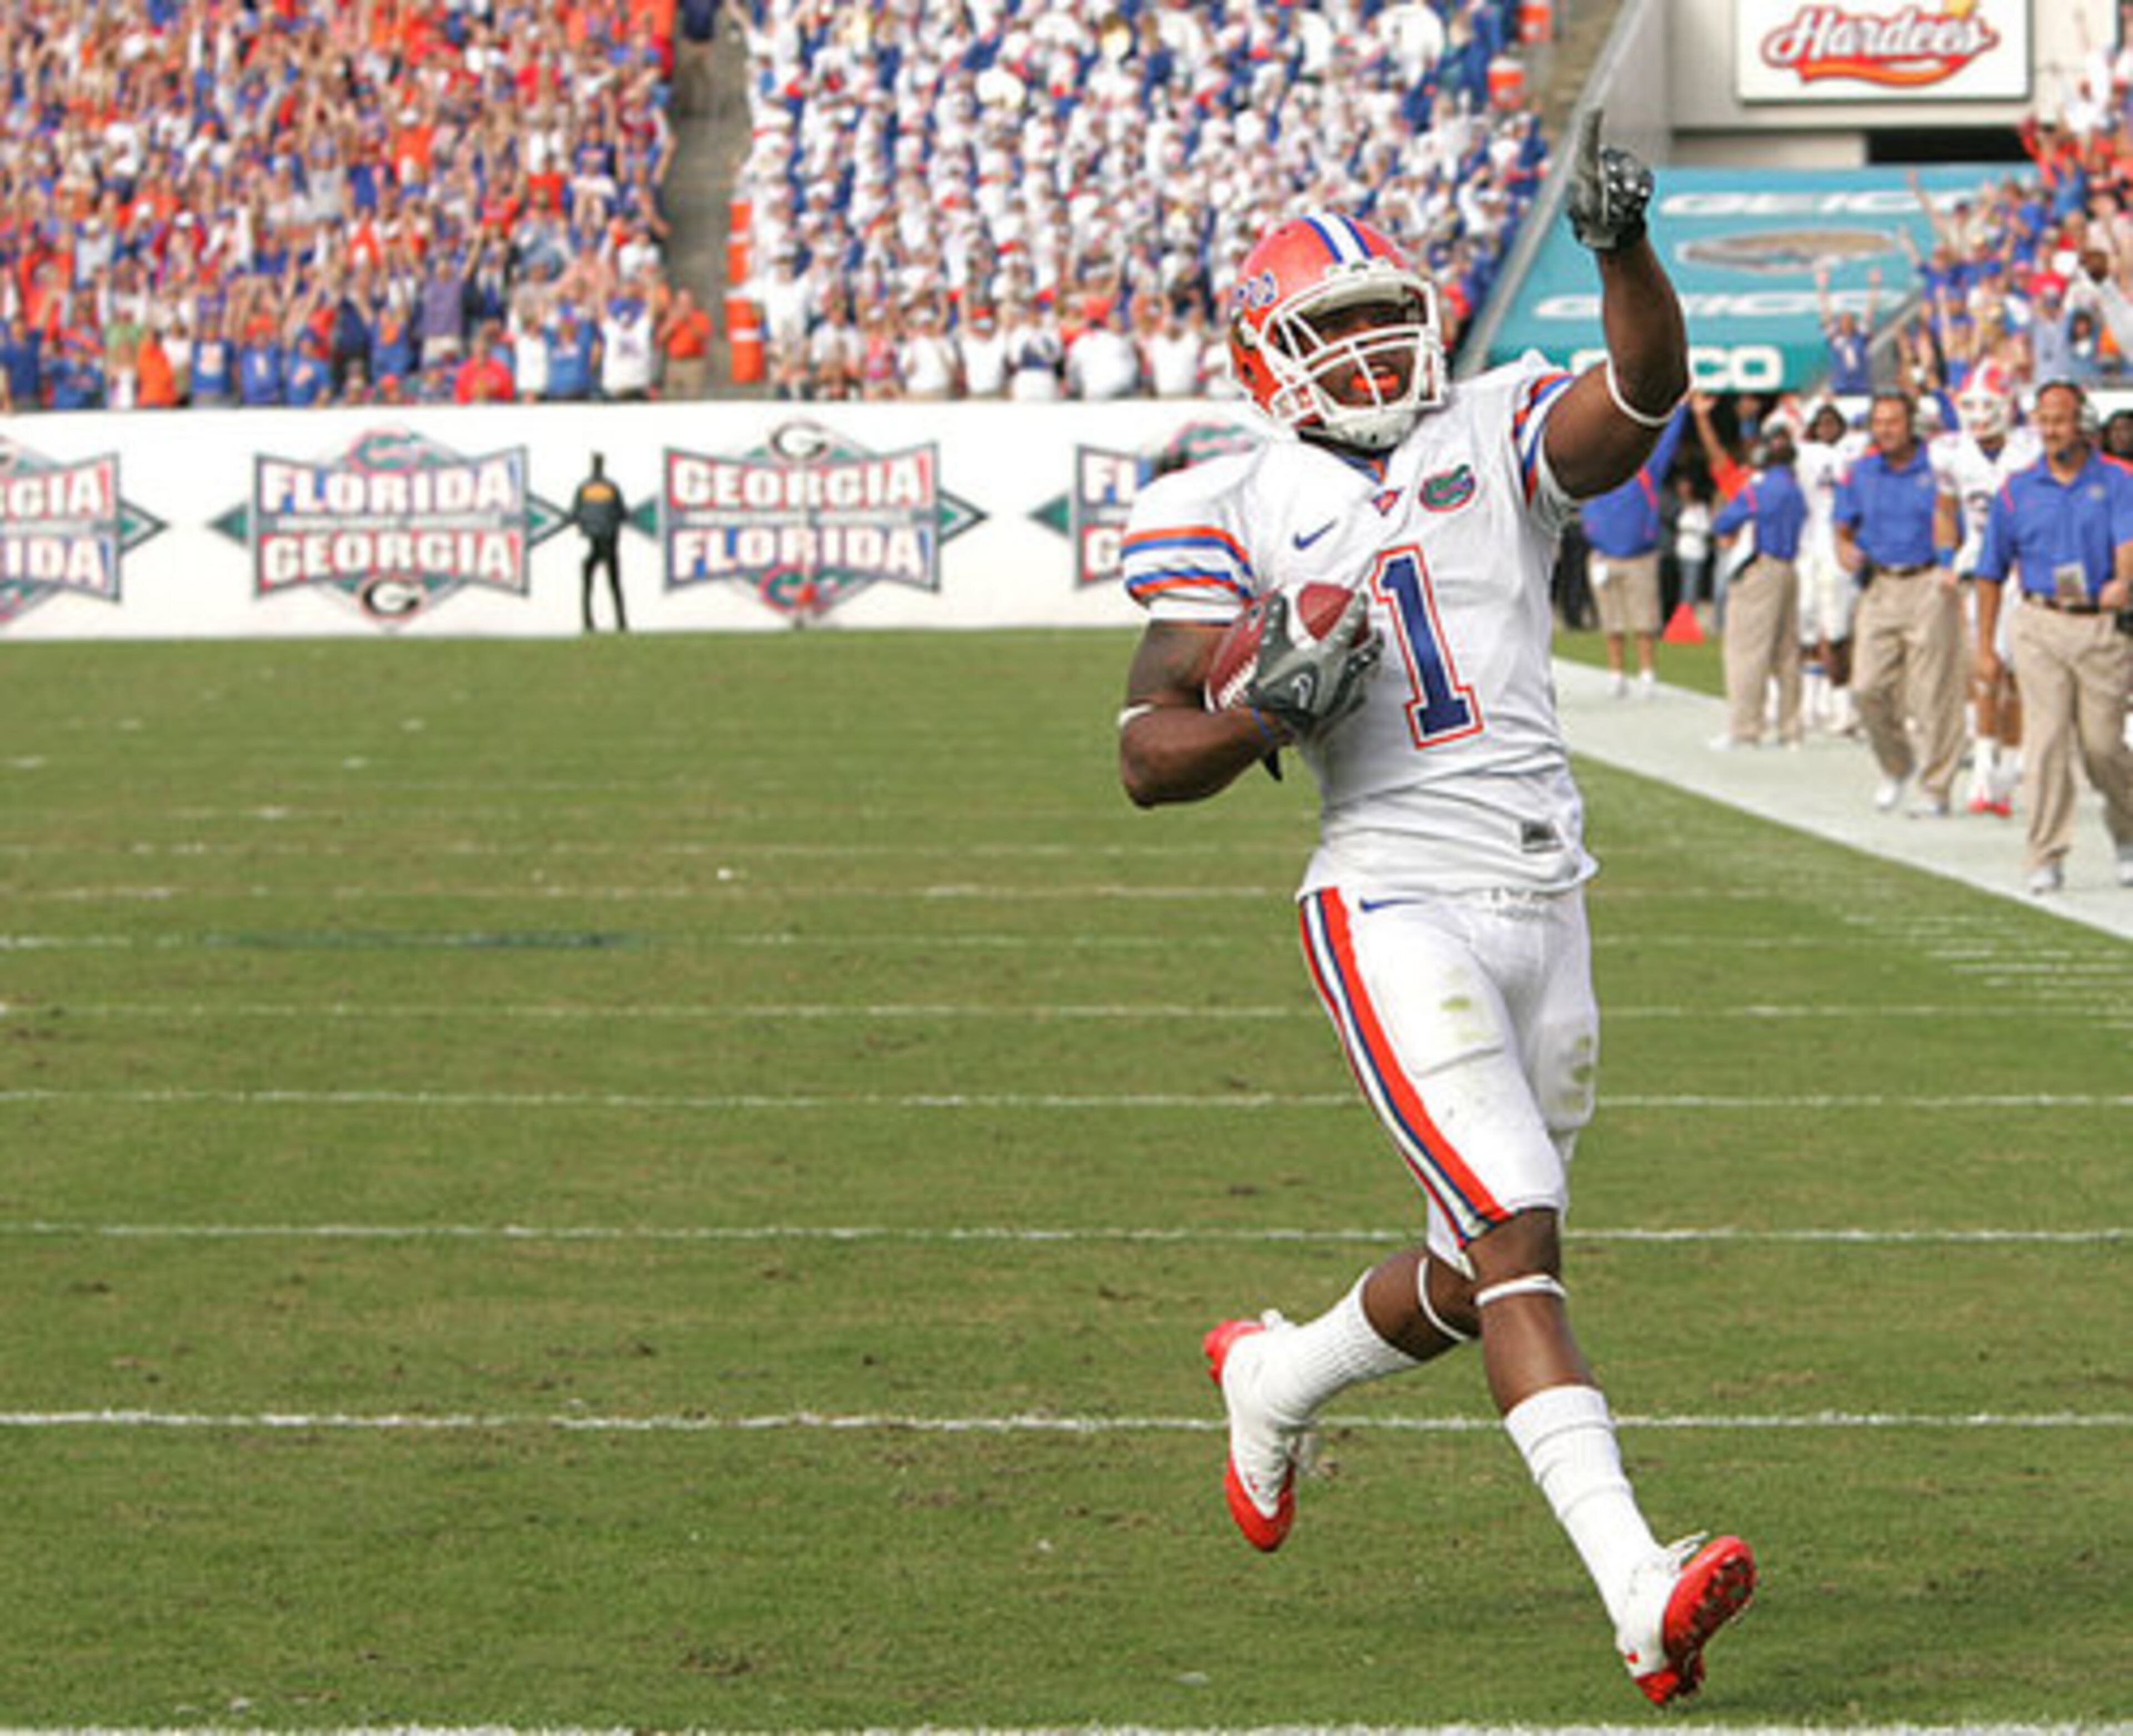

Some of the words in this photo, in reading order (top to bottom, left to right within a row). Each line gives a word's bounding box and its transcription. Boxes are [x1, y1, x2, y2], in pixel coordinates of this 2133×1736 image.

[259, 456, 522, 515] FLORIDA
[669, 451, 933, 509] GEORGIA
[259, 530, 522, 590] GEORGIA
[670, 526, 933, 584] FLORIDA
[1370, 543, 1482, 748] 1
